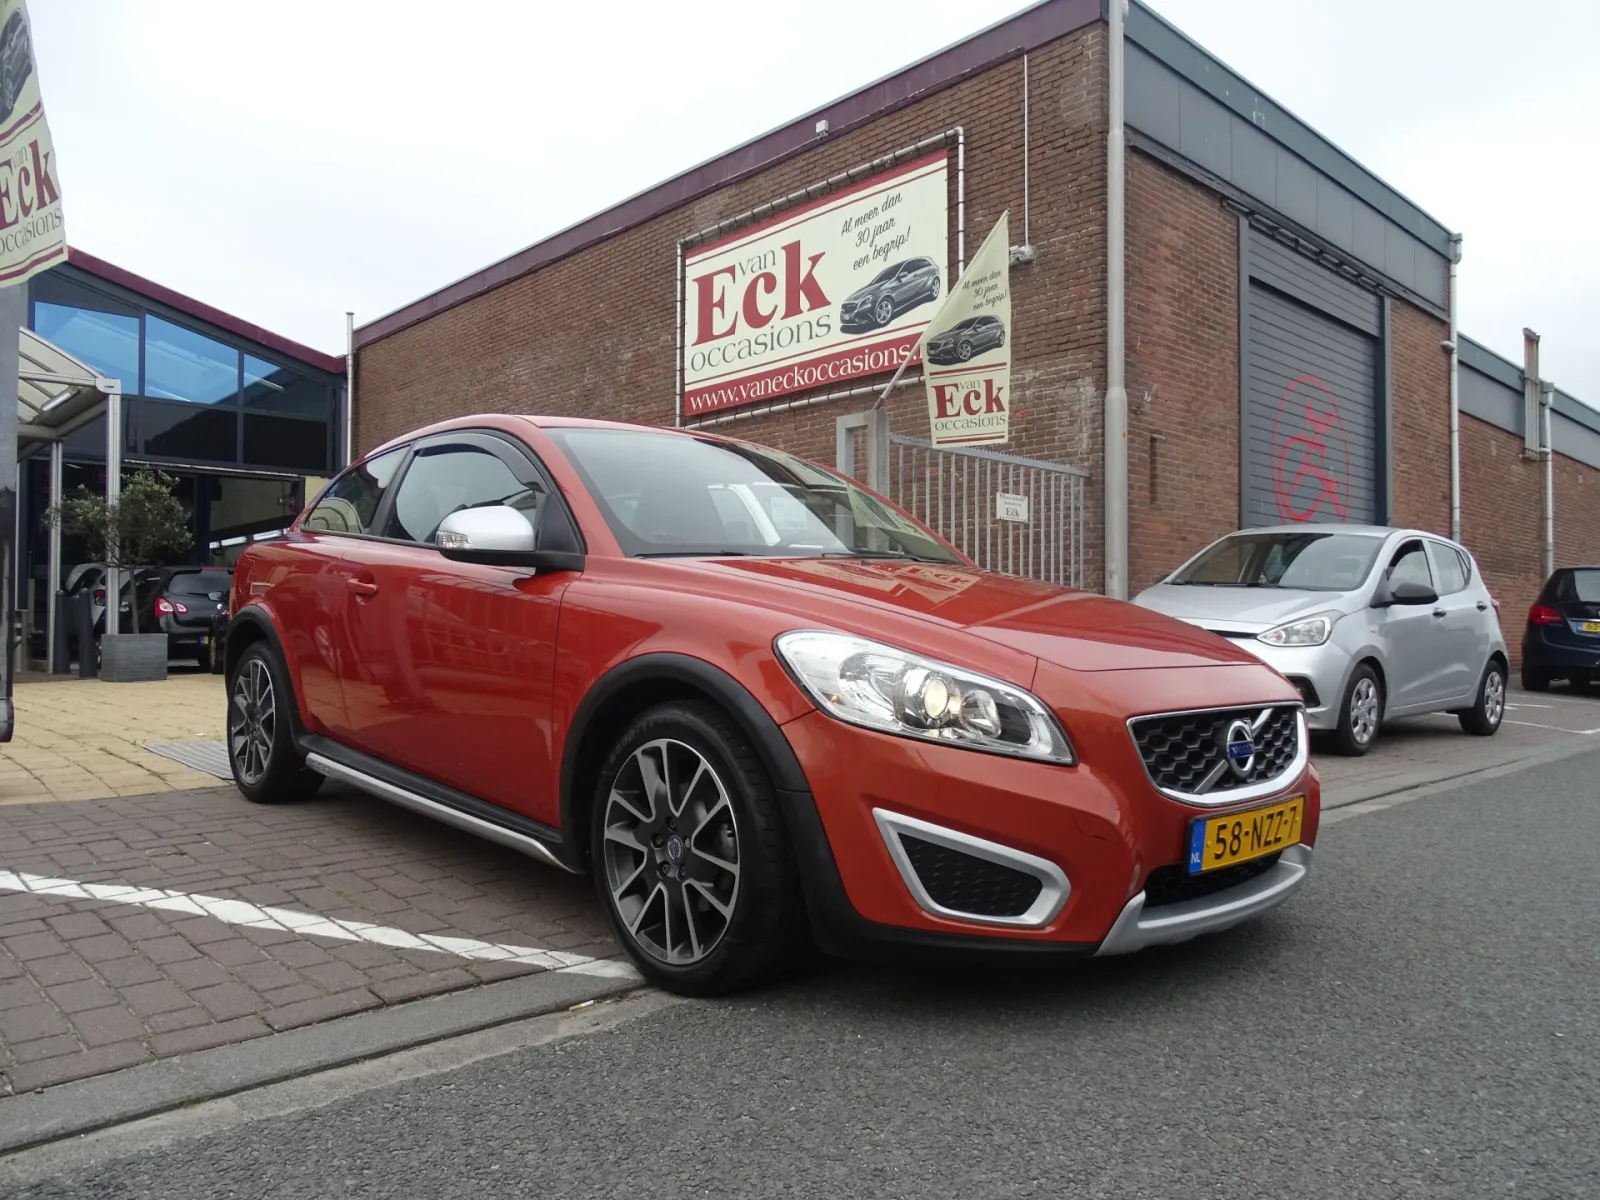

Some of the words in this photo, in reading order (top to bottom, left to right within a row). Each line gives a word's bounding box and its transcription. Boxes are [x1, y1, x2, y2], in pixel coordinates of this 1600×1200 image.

[11, 146, 28, 168] van
[0, 138, 59, 231] Eck
[841, 217, 853, 236] Al
[854, 206, 880, 229] meer
[881, 192, 903, 213] dan
[853, 254, 871, 271] een
[872, 224, 911, 262] begrip!
[855, 227, 871, 248] 30
[869, 217, 896, 248] jaar
[738, 249, 776, 277] van
[691, 239, 832, 347] Eck
[973, 286, 983, 298] 30
[982, 283, 998, 299] jaar
[690, 314, 832, 372] occasions
[931, 378, 1006, 419] Eck
[960, 379, 981, 390] van
[934, 414, 1006, 432] occasions
[1213, 805, 1298, 861] 58-NZZ-7
[1190, 851, 1201, 863] NL
